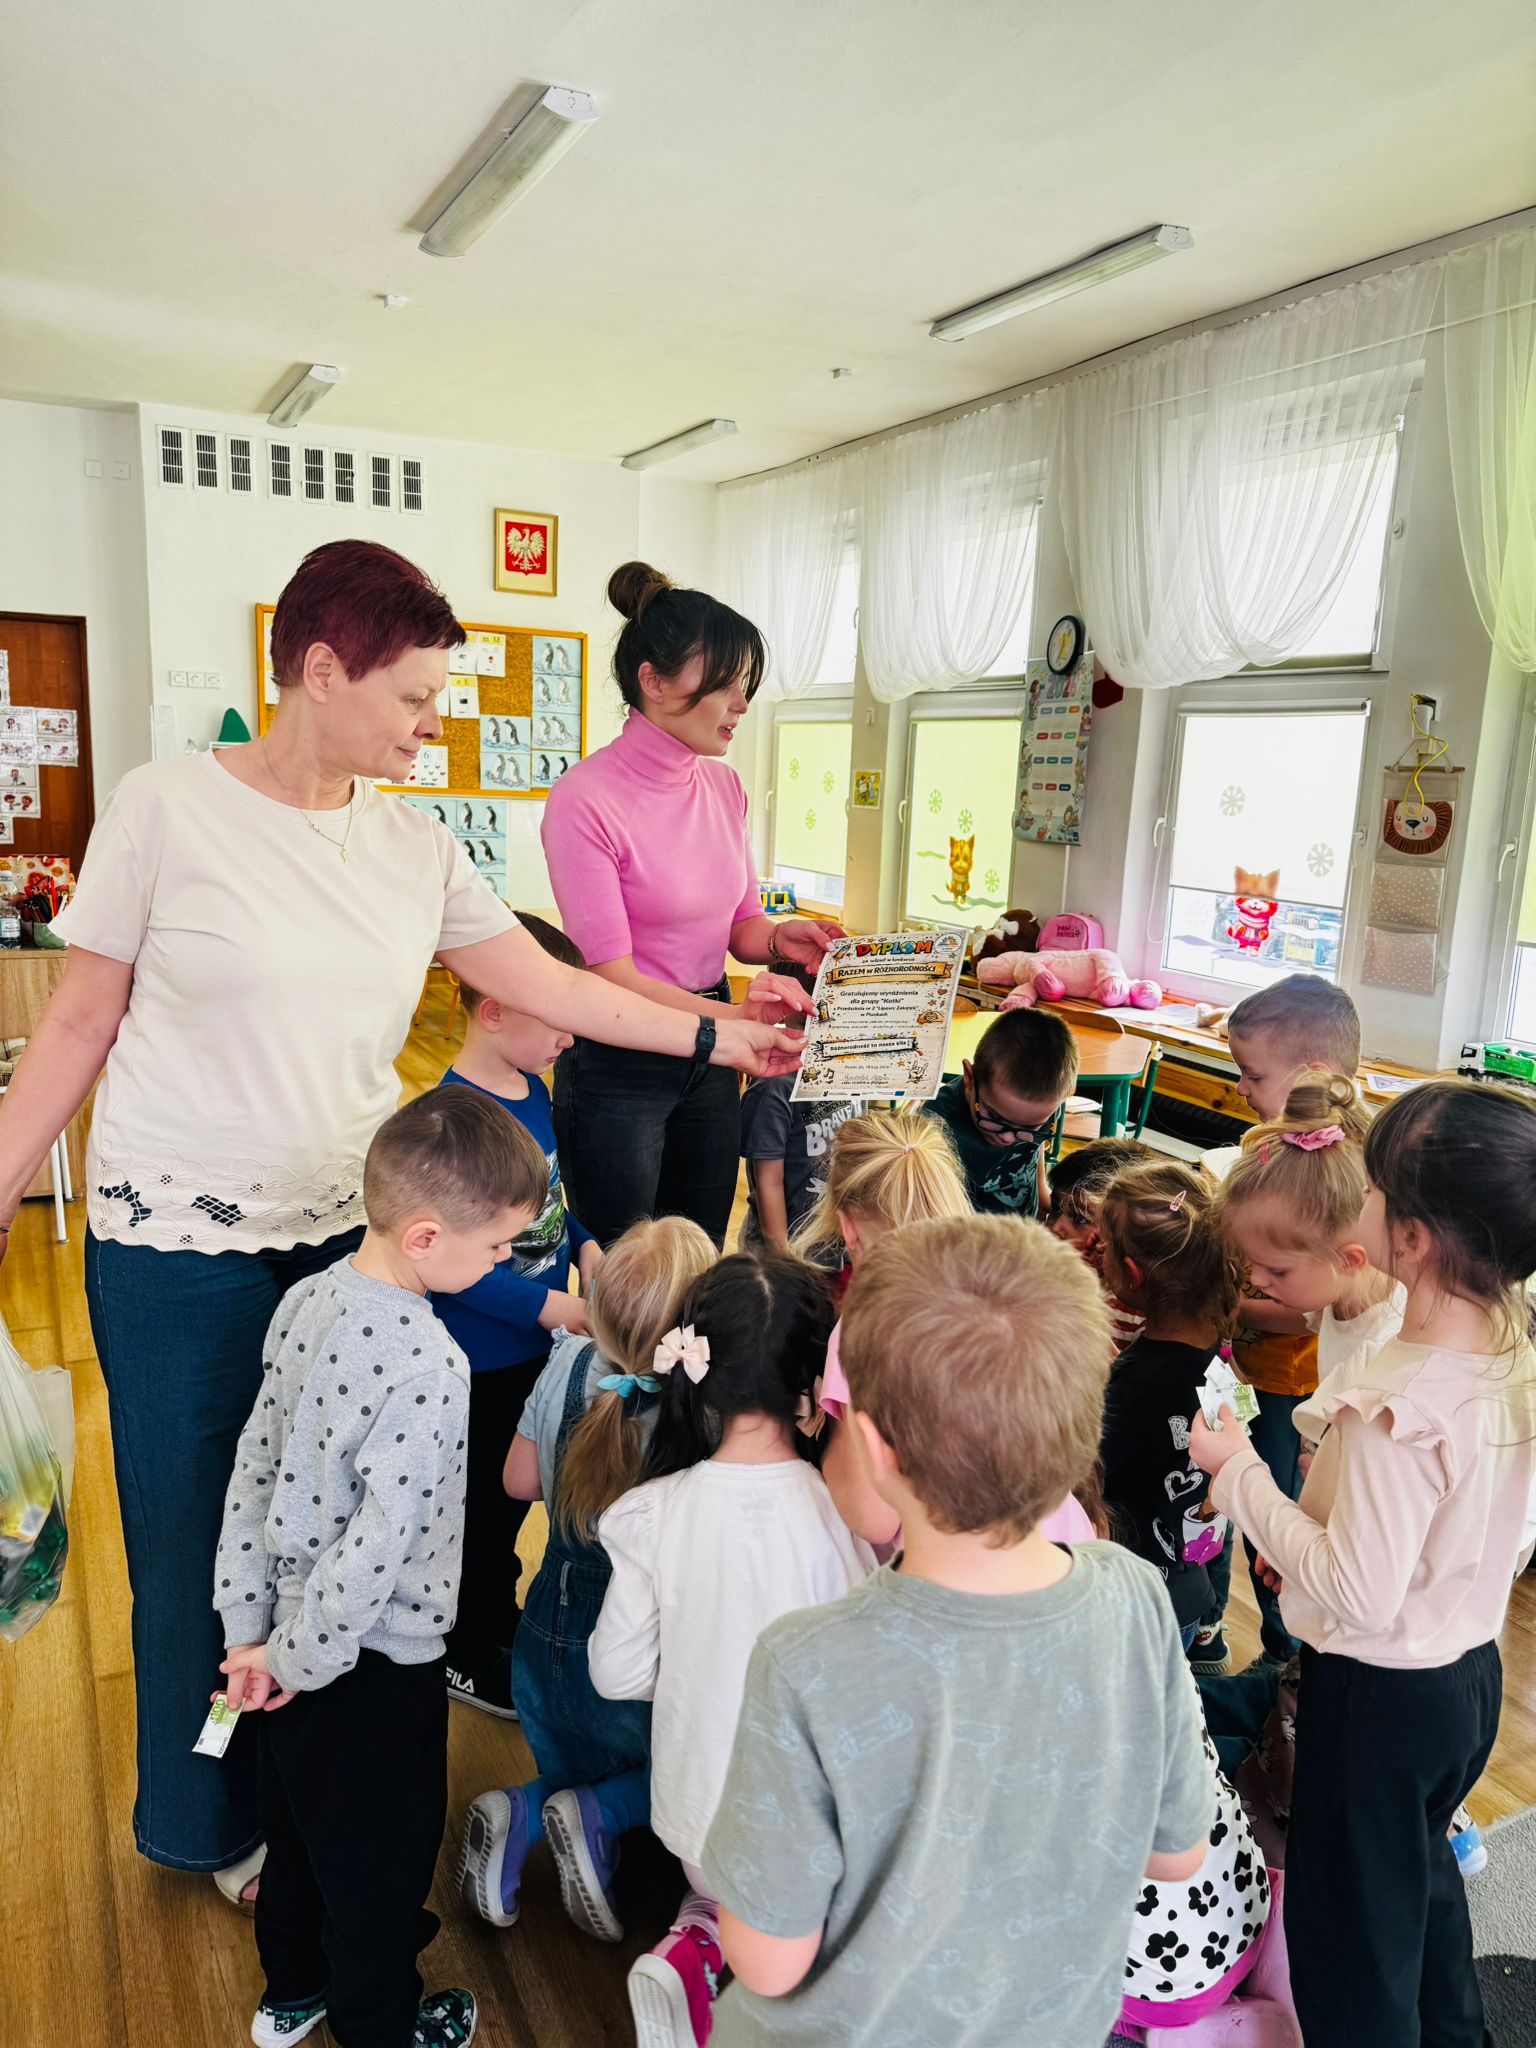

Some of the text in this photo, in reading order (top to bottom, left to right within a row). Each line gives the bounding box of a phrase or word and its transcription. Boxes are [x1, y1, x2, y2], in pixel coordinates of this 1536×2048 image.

[423, 751, 429, 759] 6
[856, 940, 934, 957] DYPLOM
[838, 967, 865, 977] RAZEM
[210, 1699, 226, 1720] 100
